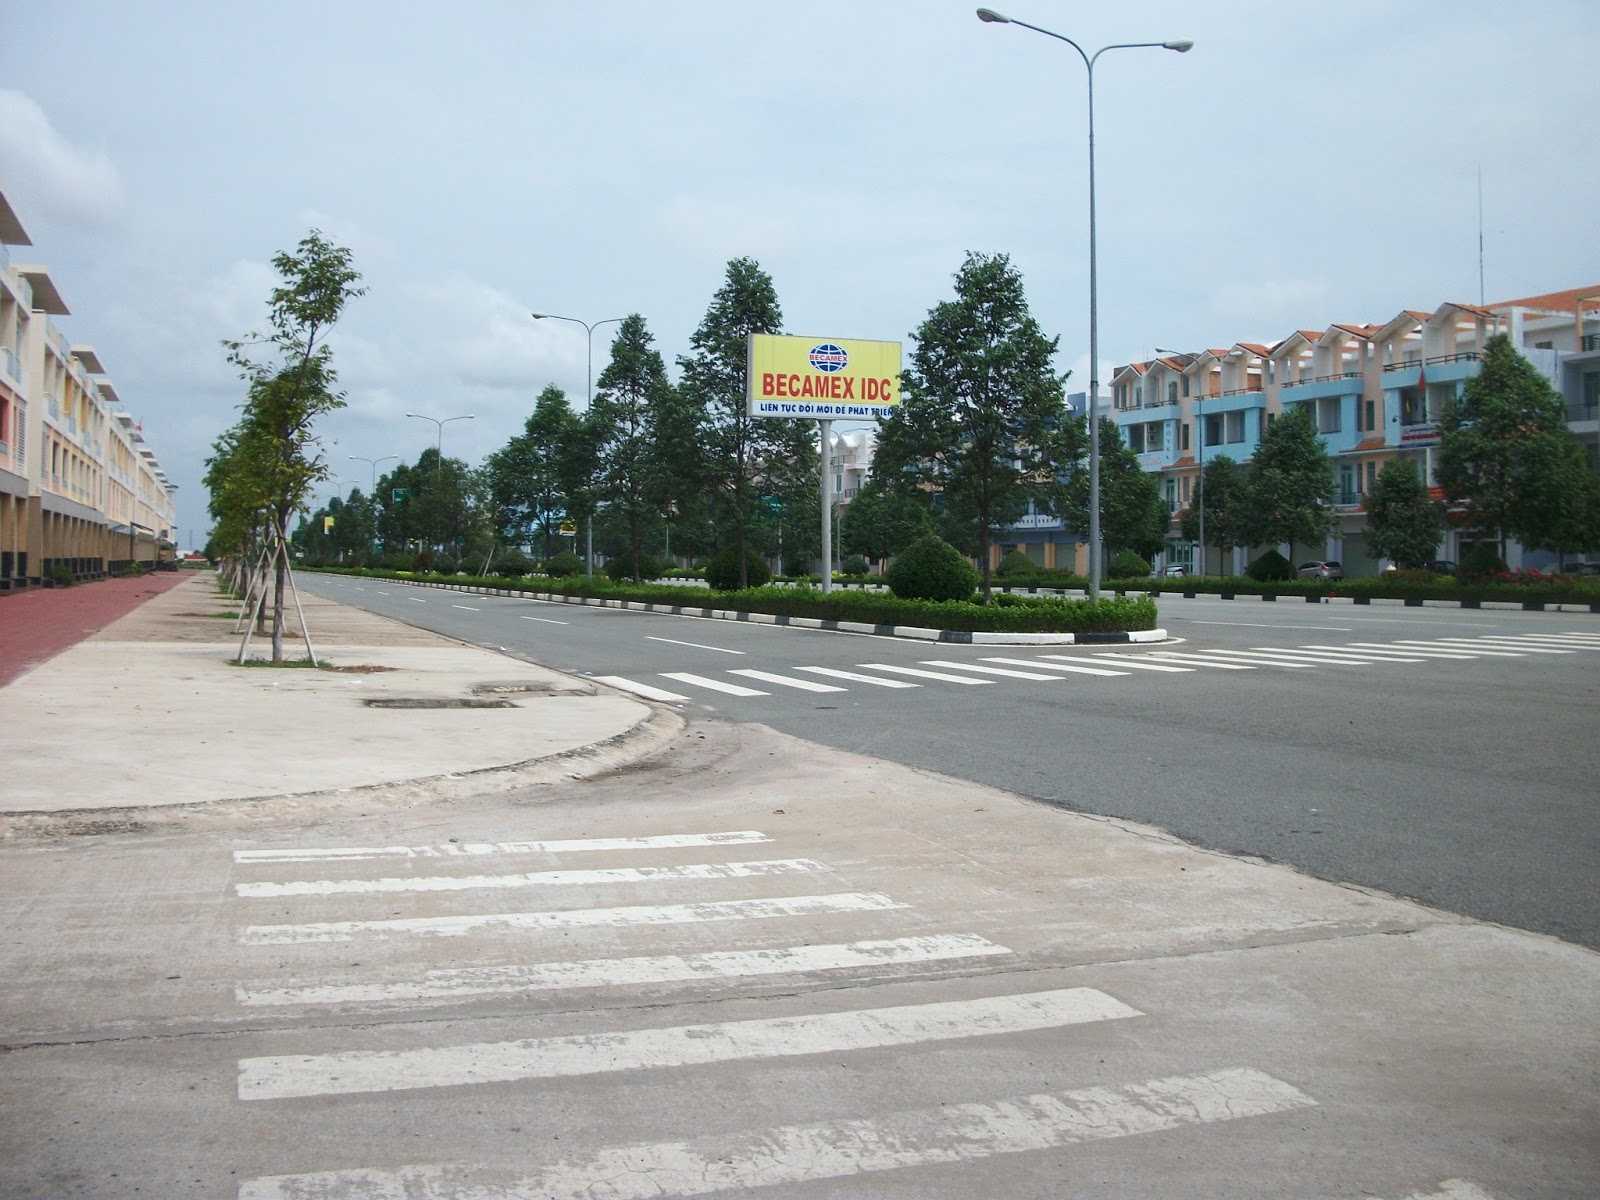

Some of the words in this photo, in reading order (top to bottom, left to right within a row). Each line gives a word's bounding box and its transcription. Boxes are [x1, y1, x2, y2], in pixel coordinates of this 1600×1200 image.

[809, 353, 848, 362] BECAMEX
[762, 373, 854, 399] BECAMEX
[861, 377, 892, 401] IDC
